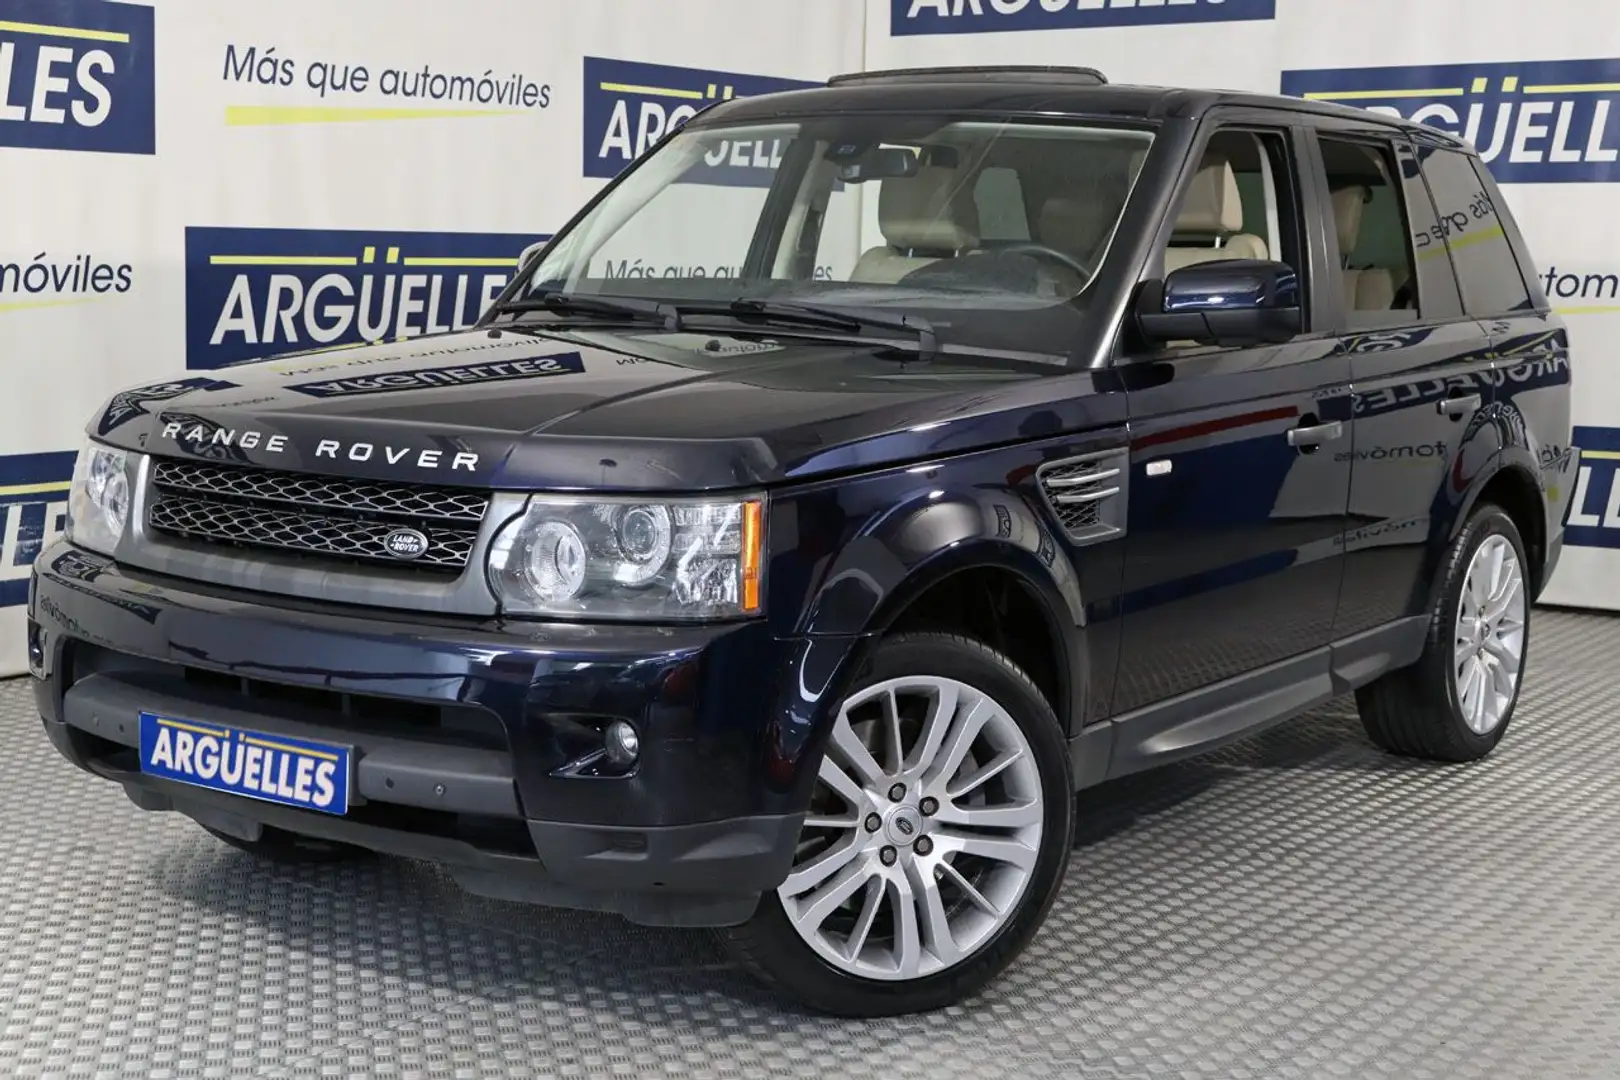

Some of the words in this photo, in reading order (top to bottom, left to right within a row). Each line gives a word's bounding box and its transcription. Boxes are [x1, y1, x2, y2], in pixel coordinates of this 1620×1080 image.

[222, 44, 295, 87] Más
[306, 62, 370, 98] que
[379, 65, 551, 109] automóviles
[1539, 266, 1619, 298] tom
[162, 421, 289, 453] RANGE
[315, 439, 480, 472] ROVER
[150, 727, 336, 807] ARGÜELLES
